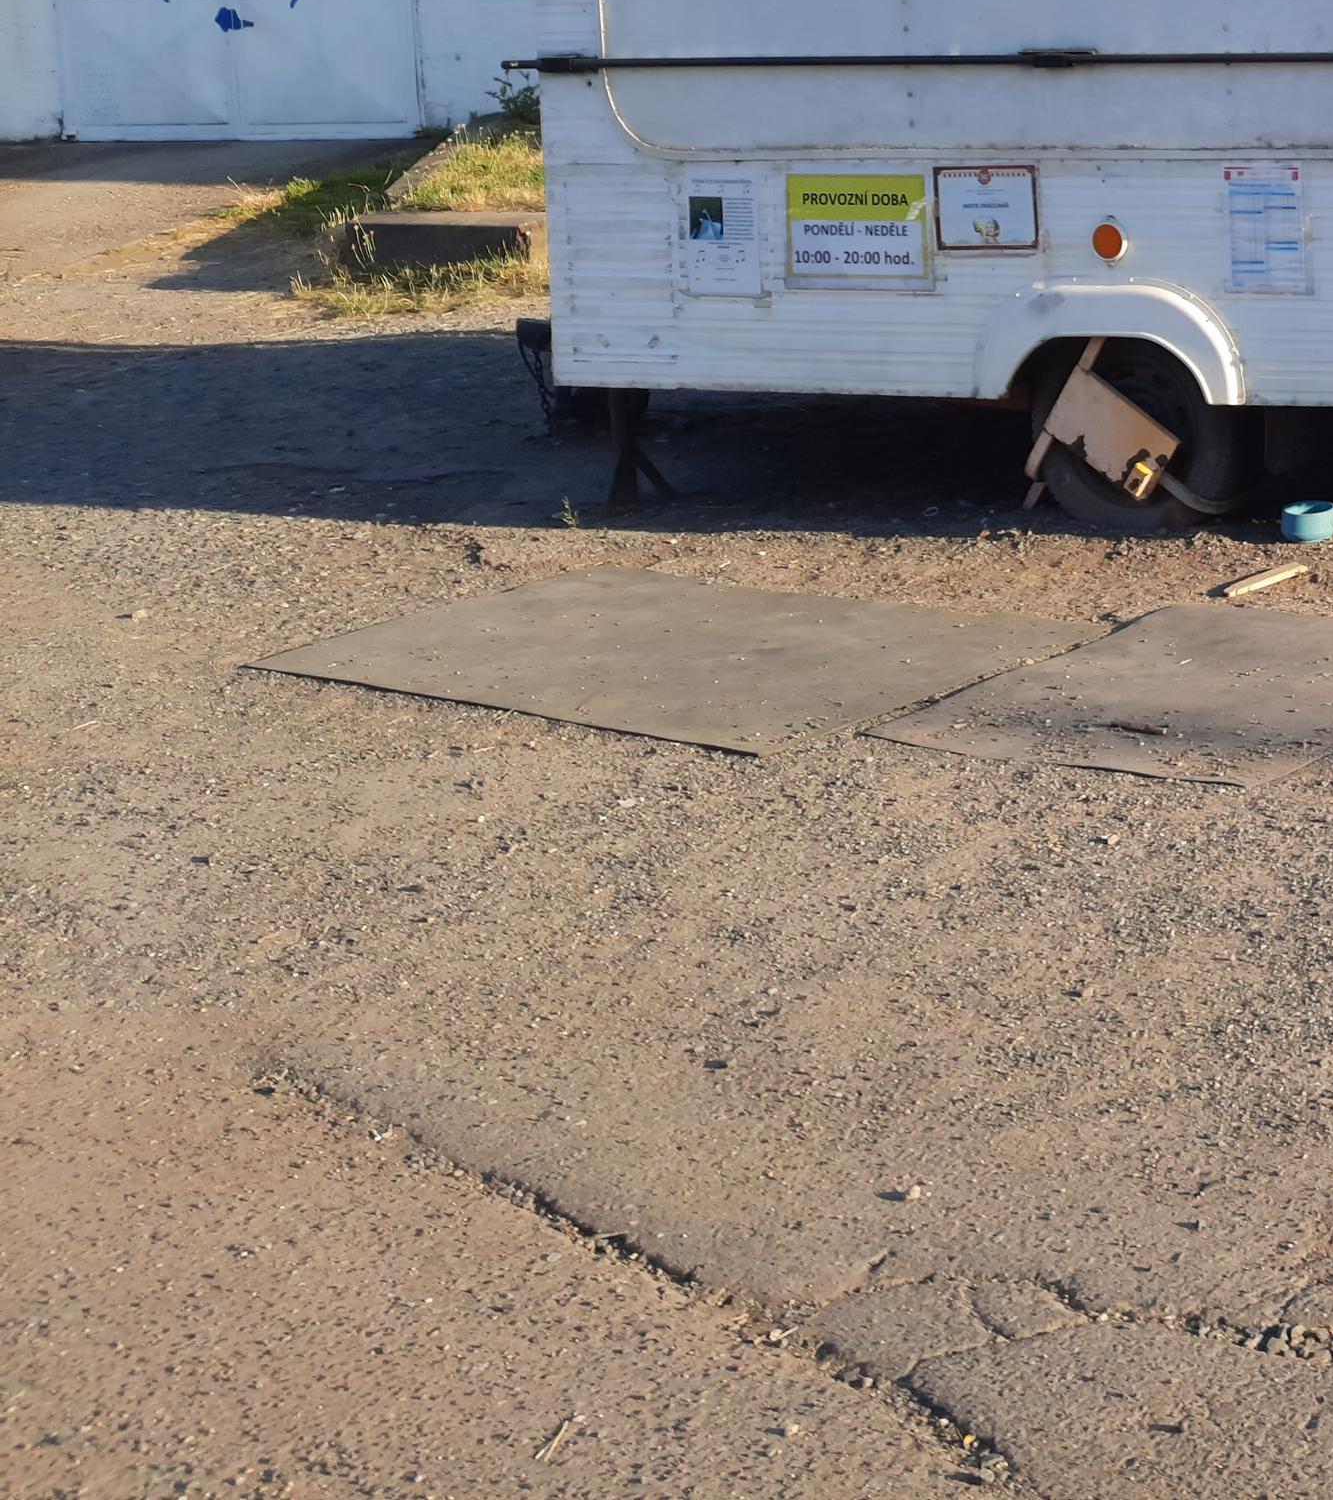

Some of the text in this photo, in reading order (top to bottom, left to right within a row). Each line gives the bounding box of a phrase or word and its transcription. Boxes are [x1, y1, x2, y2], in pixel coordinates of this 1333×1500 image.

[802, 190, 909, 206] PROVOZNÍ DOBA
[803, 222, 855, 236] PONDĚLÍ
[865, 222, 909, 237] NEDĚLE
[794, 250, 831, 264] 10:00
[843, 251, 881, 265] 20:00
[884, 250, 915, 265] hod.
